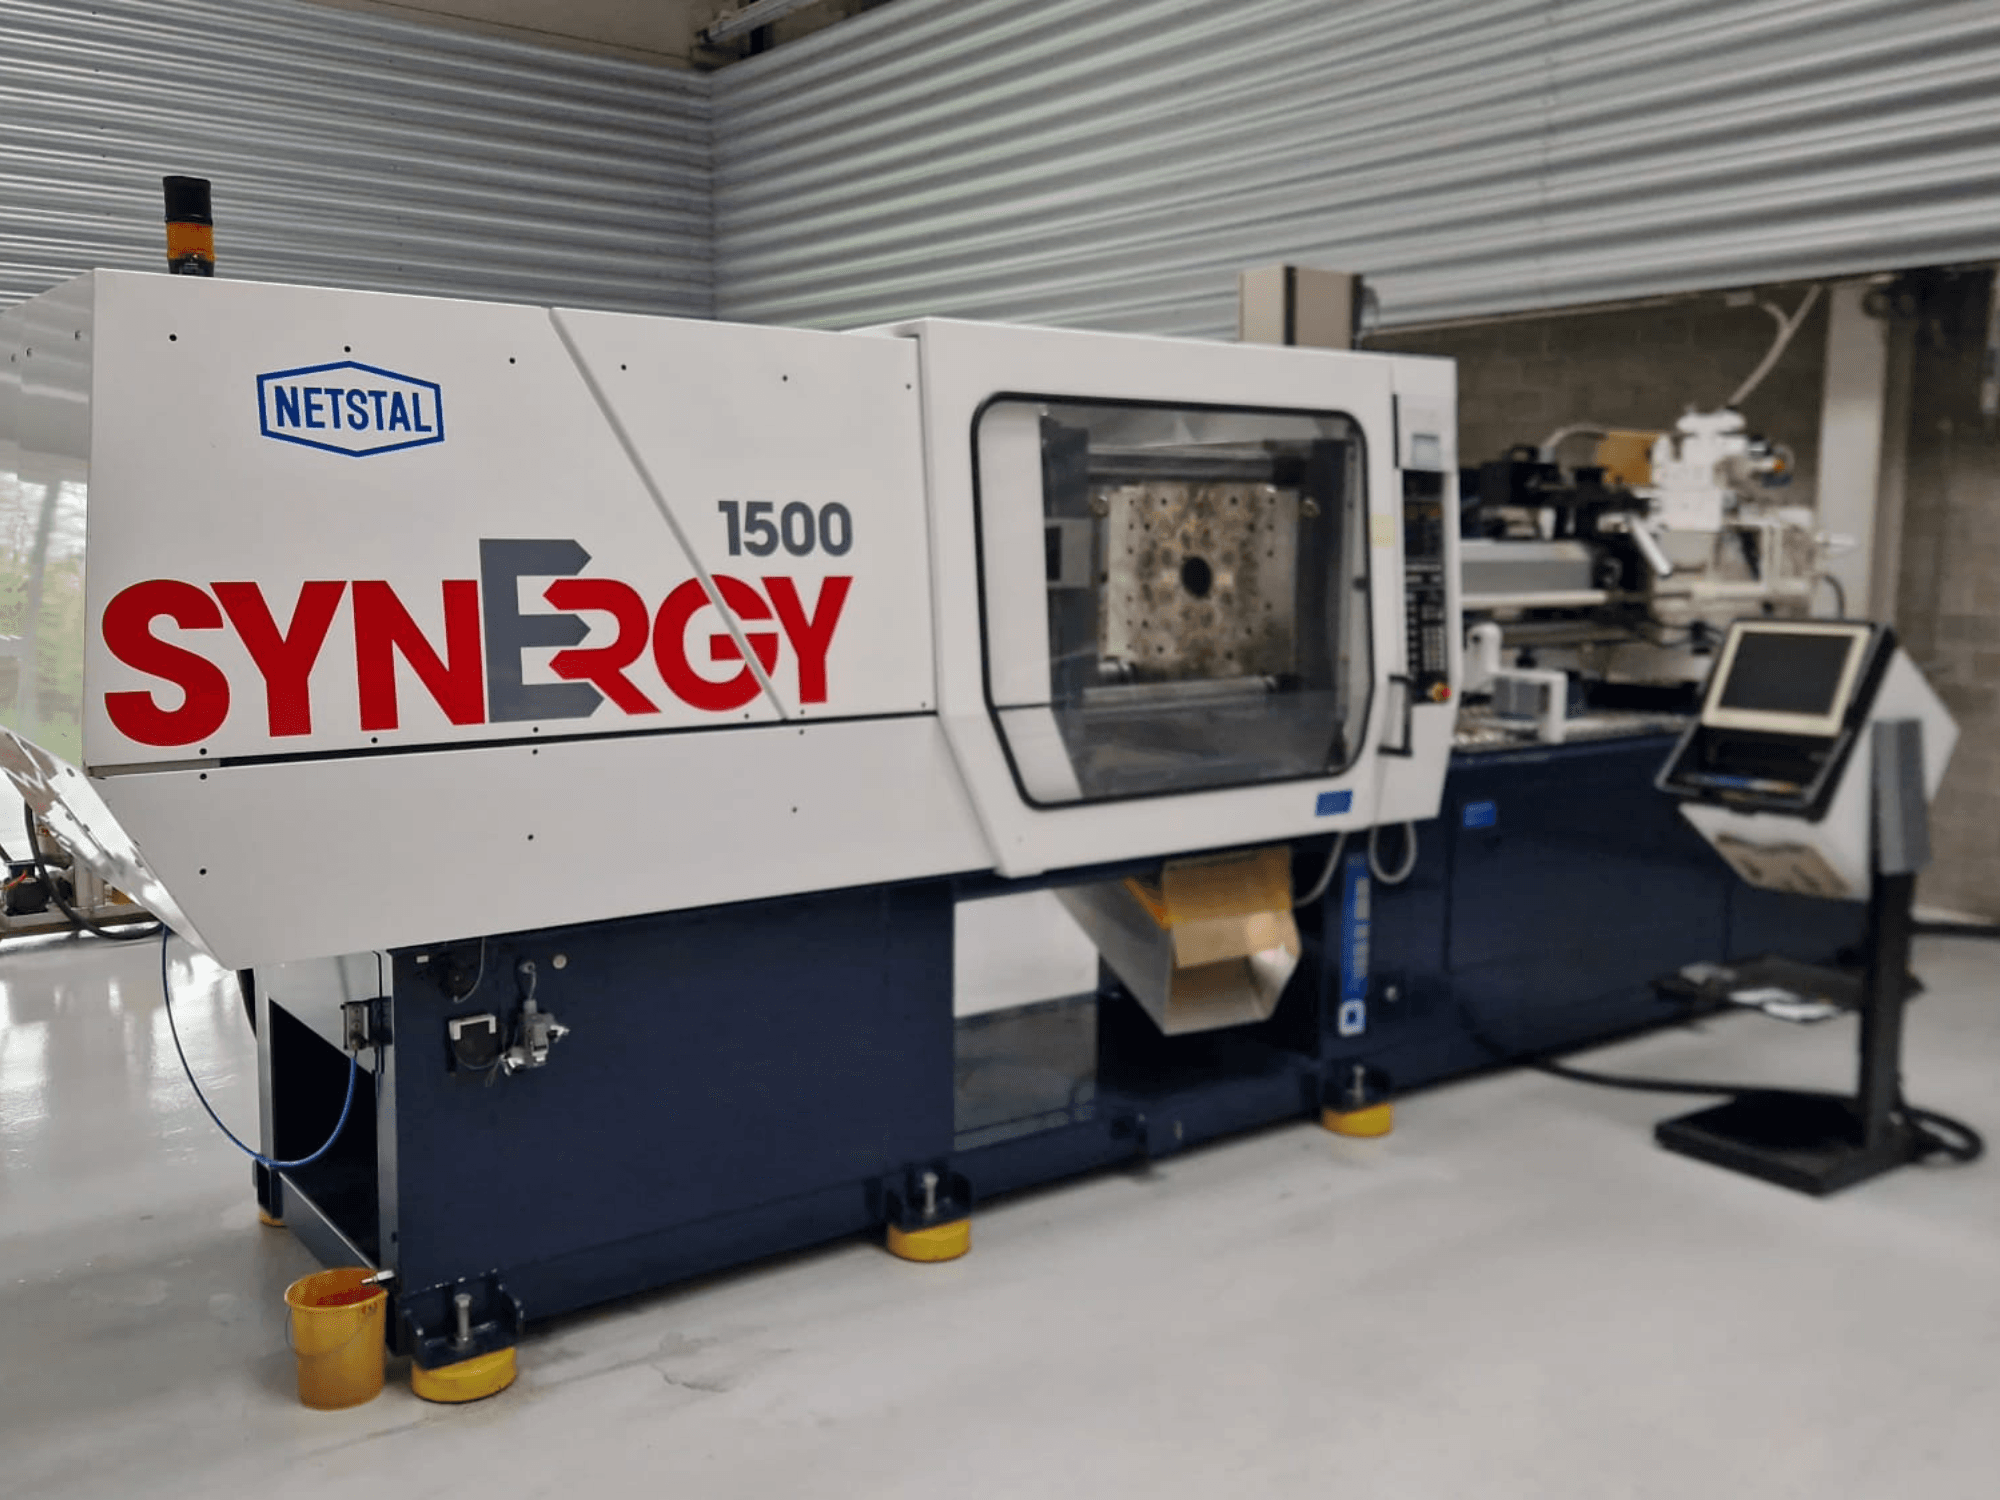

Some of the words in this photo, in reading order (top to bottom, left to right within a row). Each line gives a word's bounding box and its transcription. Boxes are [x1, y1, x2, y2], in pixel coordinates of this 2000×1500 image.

[274, 385, 433, 433] NETSTAL
[718, 500, 852, 556] 1500
[102, 538, 853, 747] SYNERGY
